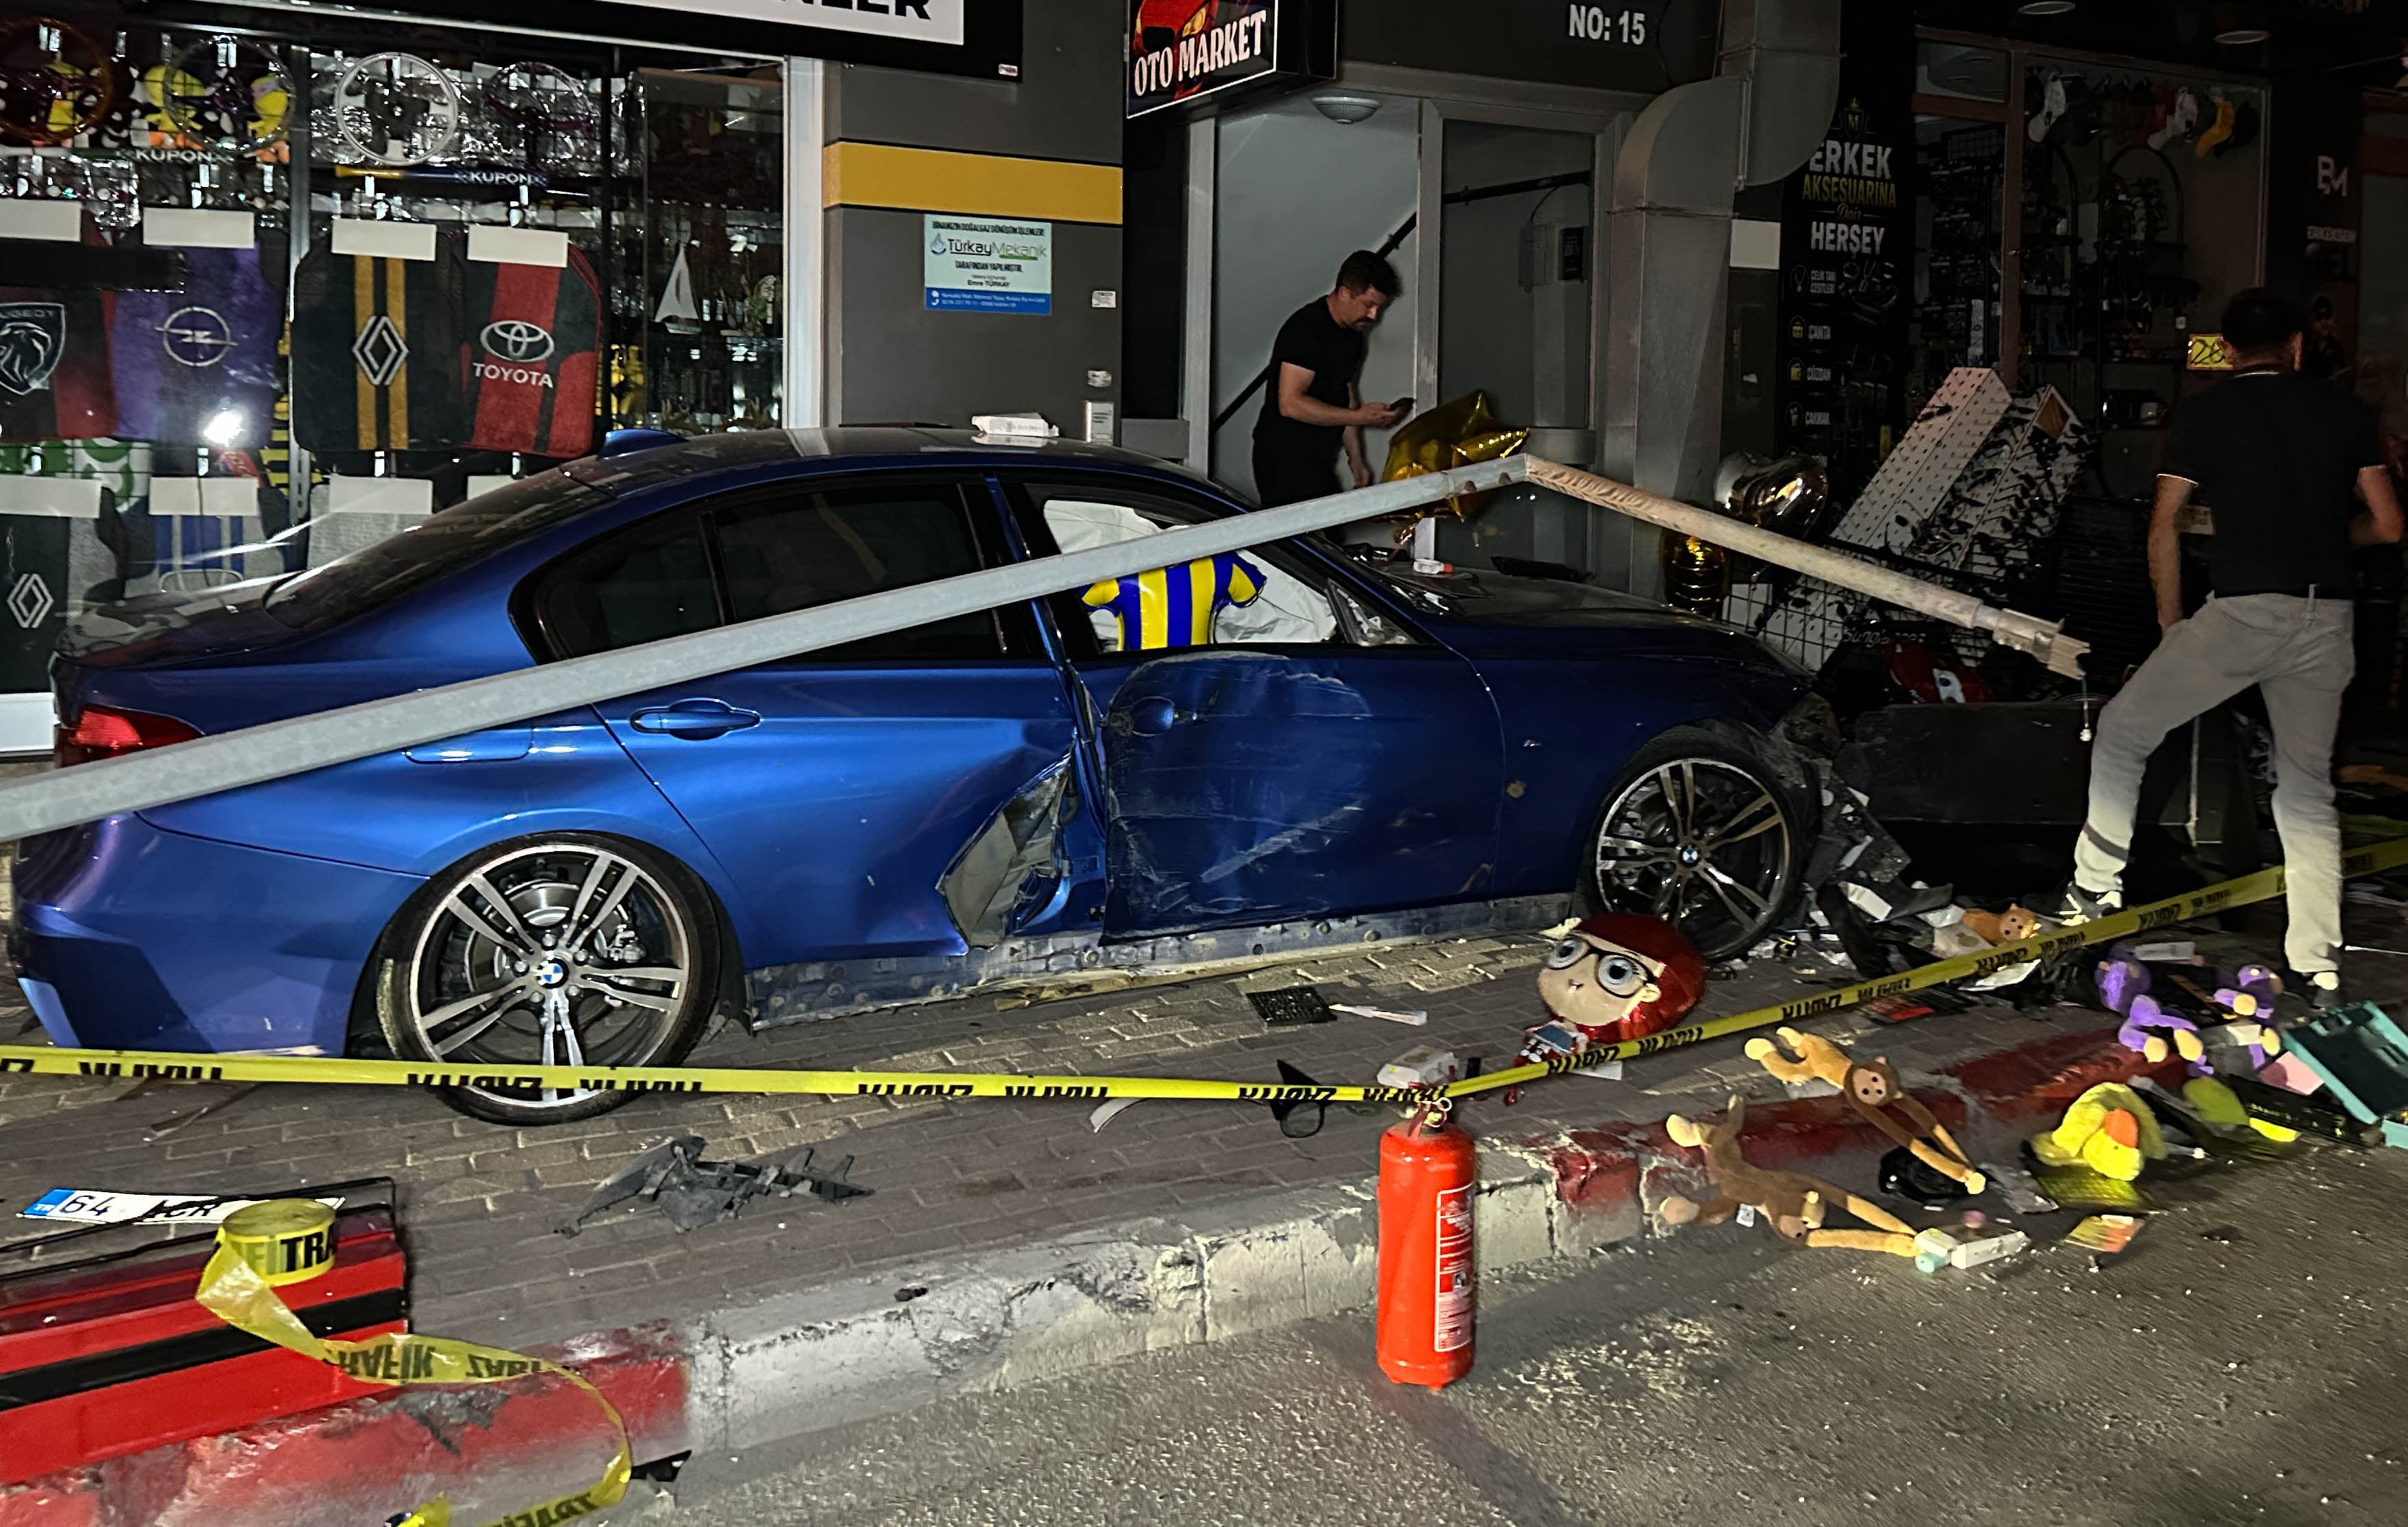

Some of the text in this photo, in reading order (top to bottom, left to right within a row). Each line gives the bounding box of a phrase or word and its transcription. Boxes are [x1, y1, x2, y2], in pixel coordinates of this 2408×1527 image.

[1568, 3, 1646, 46] NO: 15
[1134, 10, 1267, 97] OTO MARKET
[136, 149, 212, 162] KUPON
[1809, 140, 1893, 181] ERKEK
[470, 171, 531, 185] KUPON
[1802, 174, 1896, 209] AKSESUARINA
[472, 362, 555, 389] TOYOTA
[59, 1195, 116, 1216] 64
